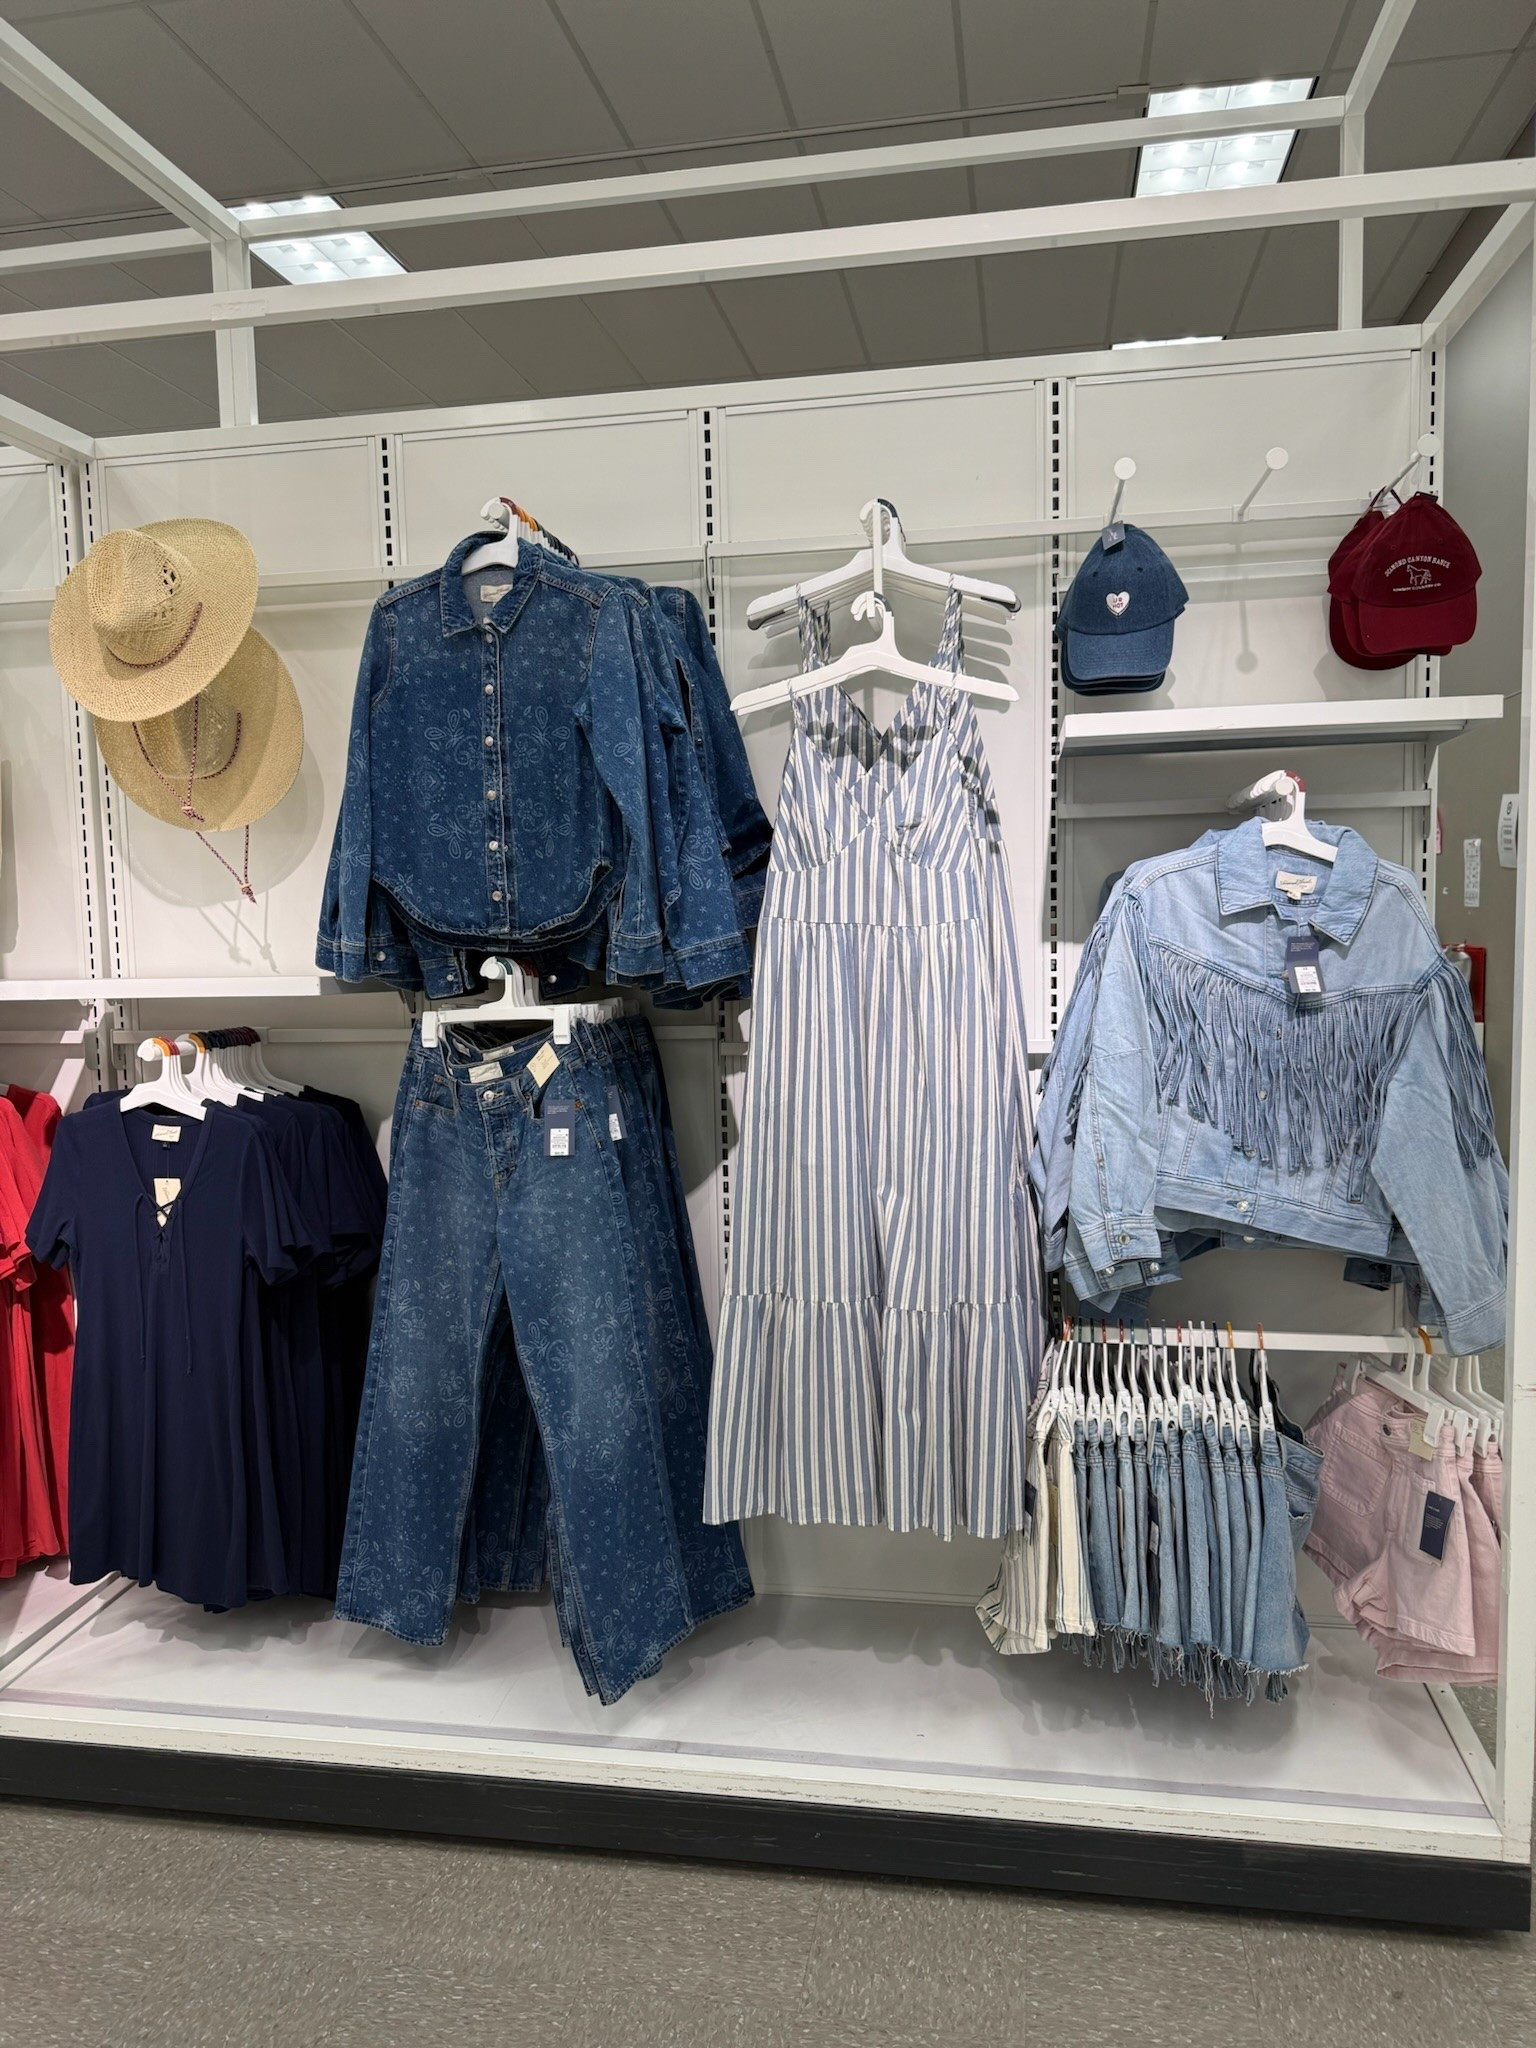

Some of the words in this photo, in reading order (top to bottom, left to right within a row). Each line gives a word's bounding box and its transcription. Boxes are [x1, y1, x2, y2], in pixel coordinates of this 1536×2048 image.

[1384, 558, 1407, 577] DIAMOND
[1407, 555, 1433, 563] CANYON
[1432, 556, 1451, 569] RANCH
